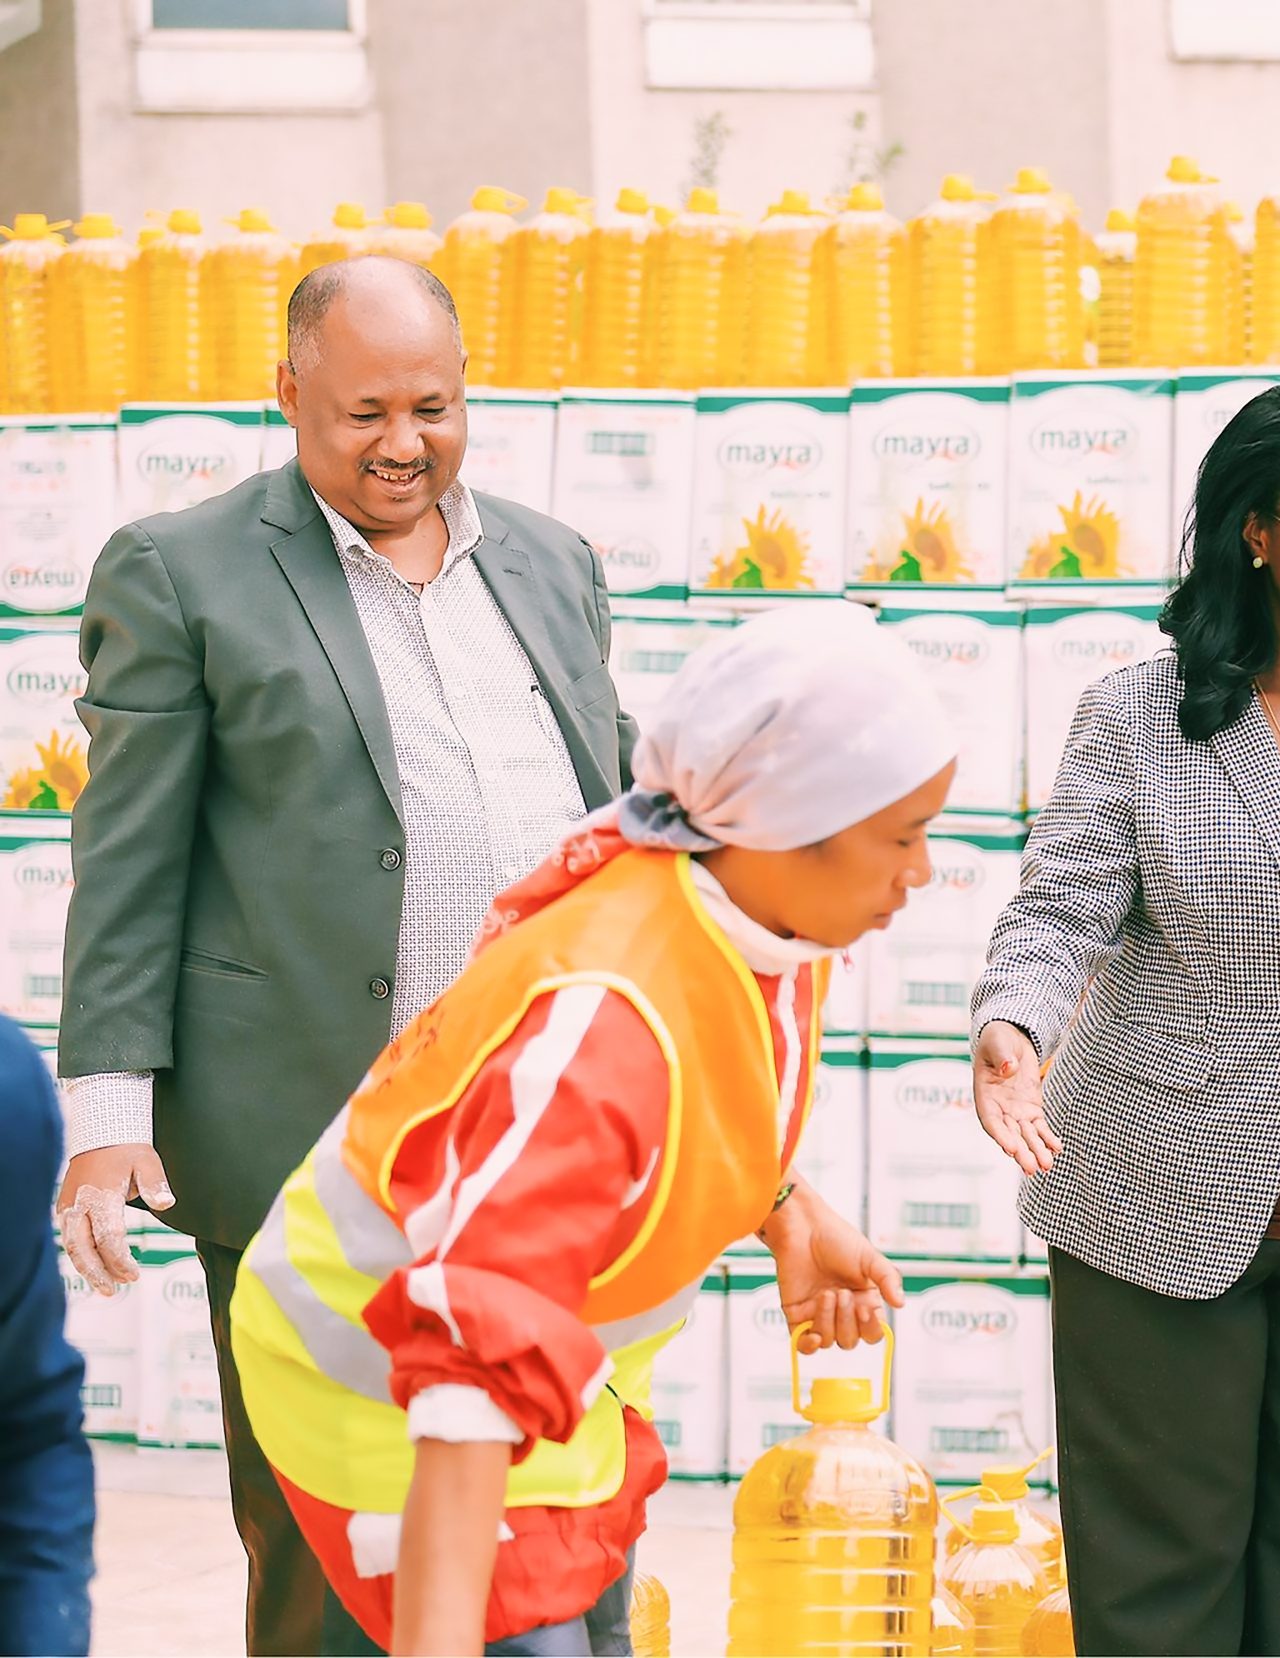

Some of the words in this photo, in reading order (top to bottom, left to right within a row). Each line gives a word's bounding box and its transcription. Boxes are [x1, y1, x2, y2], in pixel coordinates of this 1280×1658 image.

[883, 432, 971, 460] mayra
[1040, 425, 1128, 454] mayra
[146, 454, 225, 476] mayra
[727, 442, 812, 469] mayra
[604, 547, 651, 568] may
[908, 639, 981, 662] mayra
[1061, 637, 1135, 661] mayra
[17, 672, 83, 697] mayr
[22, 866, 69, 888] may
[905, 1084, 973, 1108] mayr
[930, 1308, 1007, 1333] mayra
